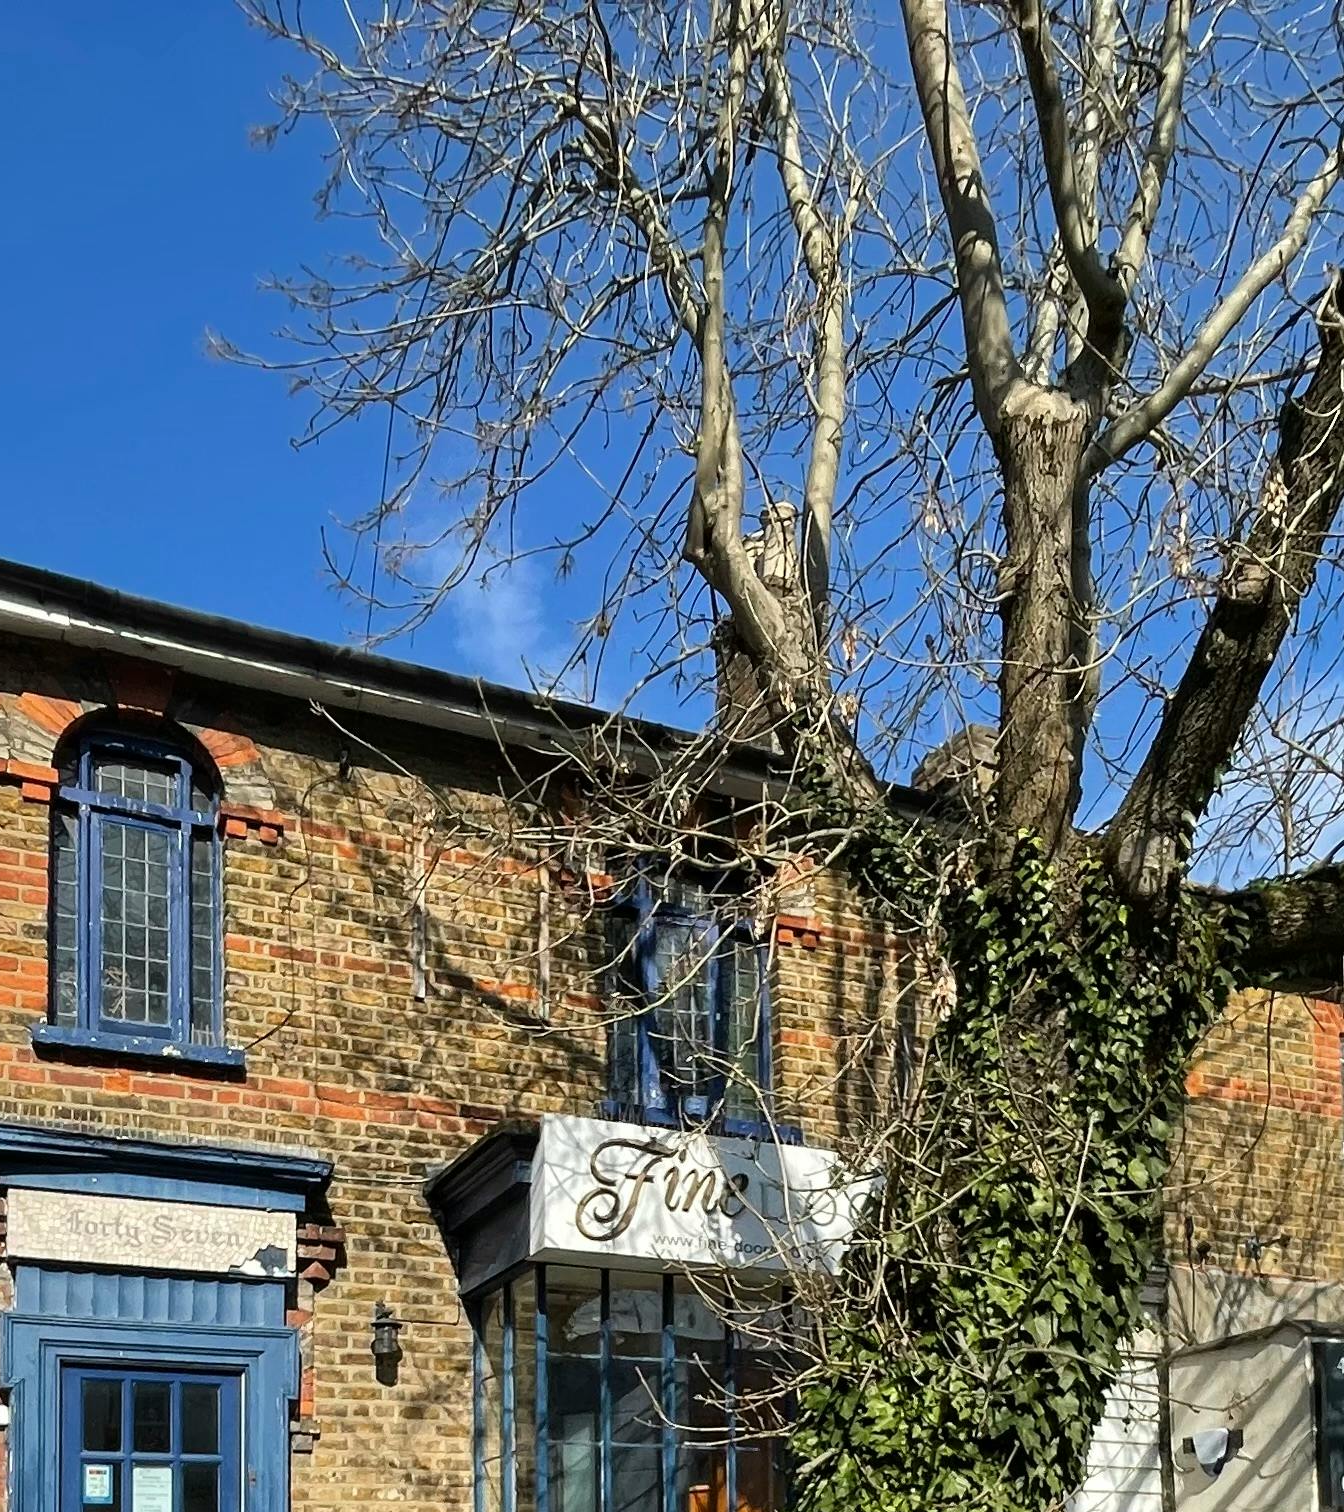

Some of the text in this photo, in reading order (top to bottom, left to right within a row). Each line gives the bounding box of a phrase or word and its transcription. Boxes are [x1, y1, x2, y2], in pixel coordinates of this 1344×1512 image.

[576, 1137, 749, 1242] Fine
[67, 1208, 243, 1250] Forty Seven
